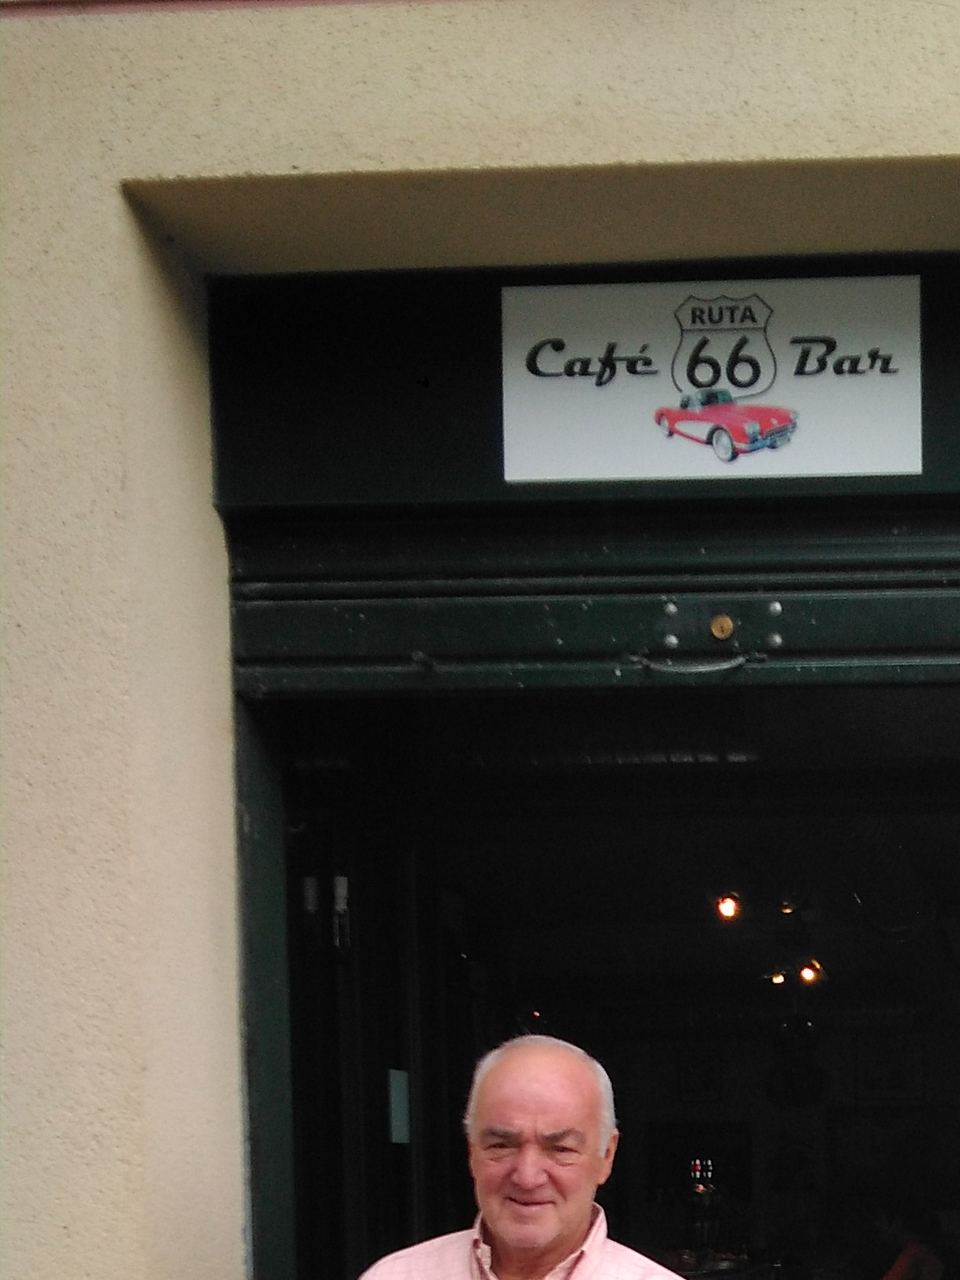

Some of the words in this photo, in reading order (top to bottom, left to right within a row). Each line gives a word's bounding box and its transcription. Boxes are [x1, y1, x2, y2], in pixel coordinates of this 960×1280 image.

[691, 306, 757, 325] RUTA
[525, 337, 658, 387] Café
[790, 335, 899, 376] Bar
[686, 336, 761, 388] 66
